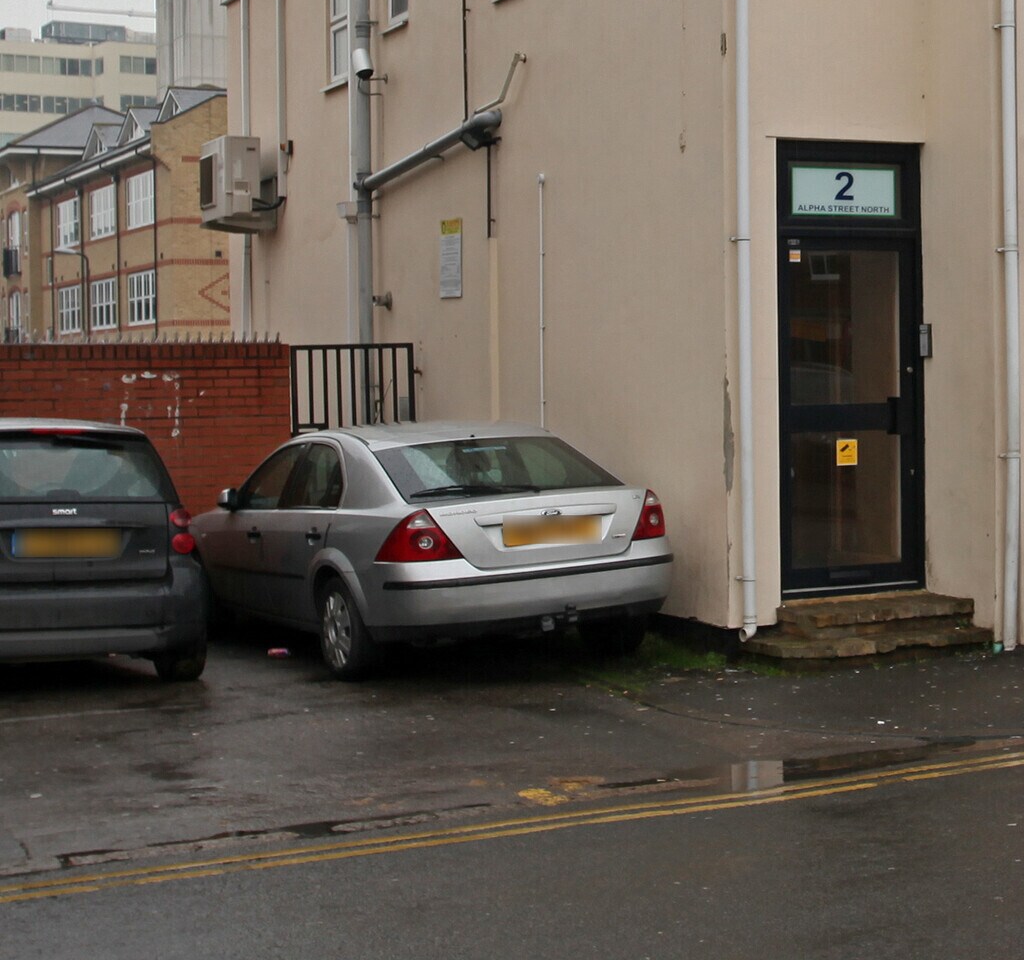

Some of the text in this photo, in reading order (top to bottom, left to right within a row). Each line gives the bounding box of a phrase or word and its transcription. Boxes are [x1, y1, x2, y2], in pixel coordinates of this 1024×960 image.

[834, 171, 854, 201] 2
[797, 204, 890, 214] ALPHA STREET NORTH
[52, 508, 77, 516] smart
